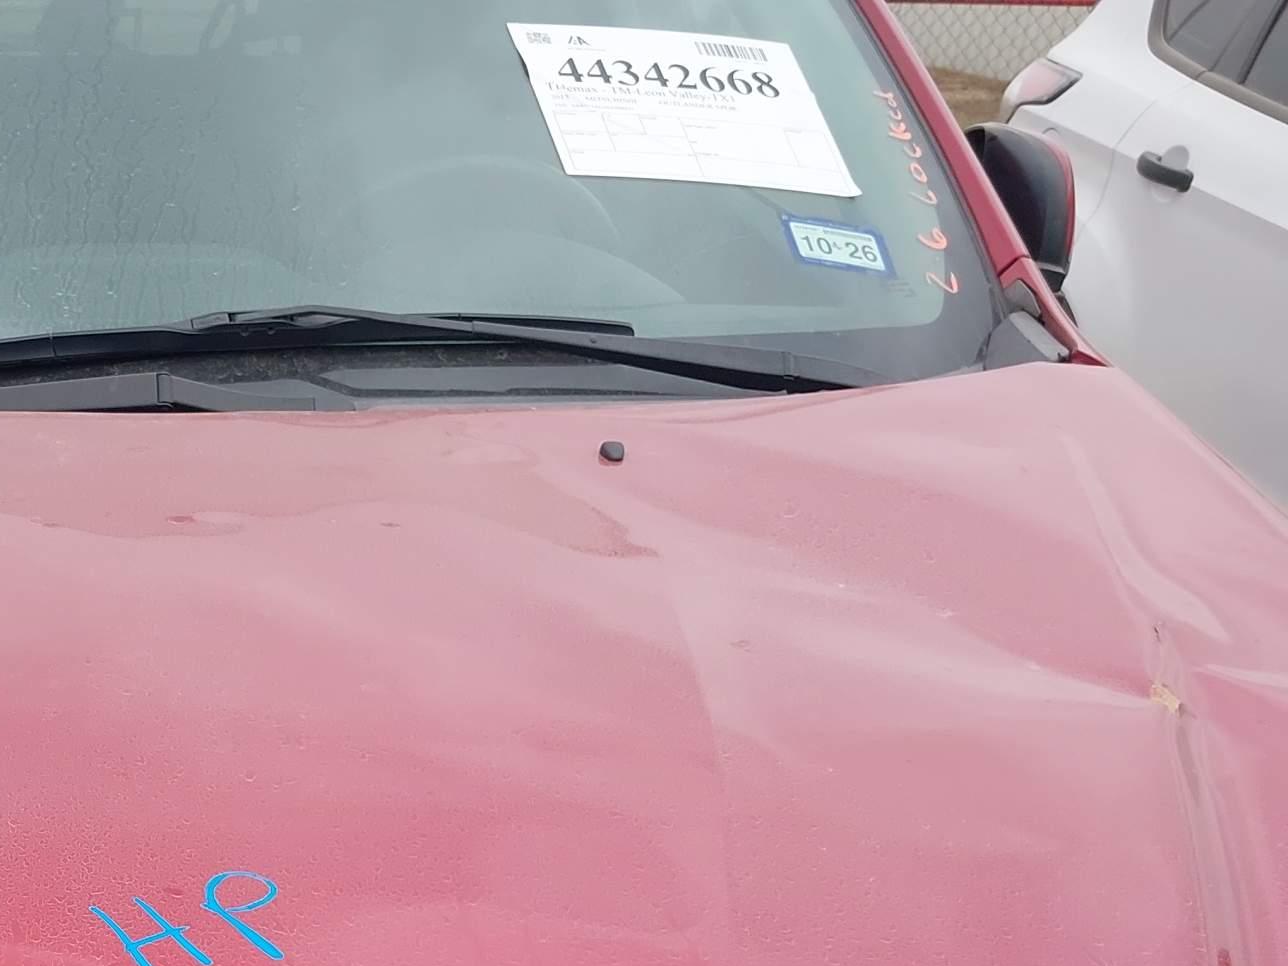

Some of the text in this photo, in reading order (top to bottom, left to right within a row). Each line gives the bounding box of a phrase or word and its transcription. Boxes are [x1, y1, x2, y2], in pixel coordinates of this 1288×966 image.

[557, 56, 781, 98] 44342668
[801, 235, 833, 256] 10
[844, 242, 878, 263] 26
